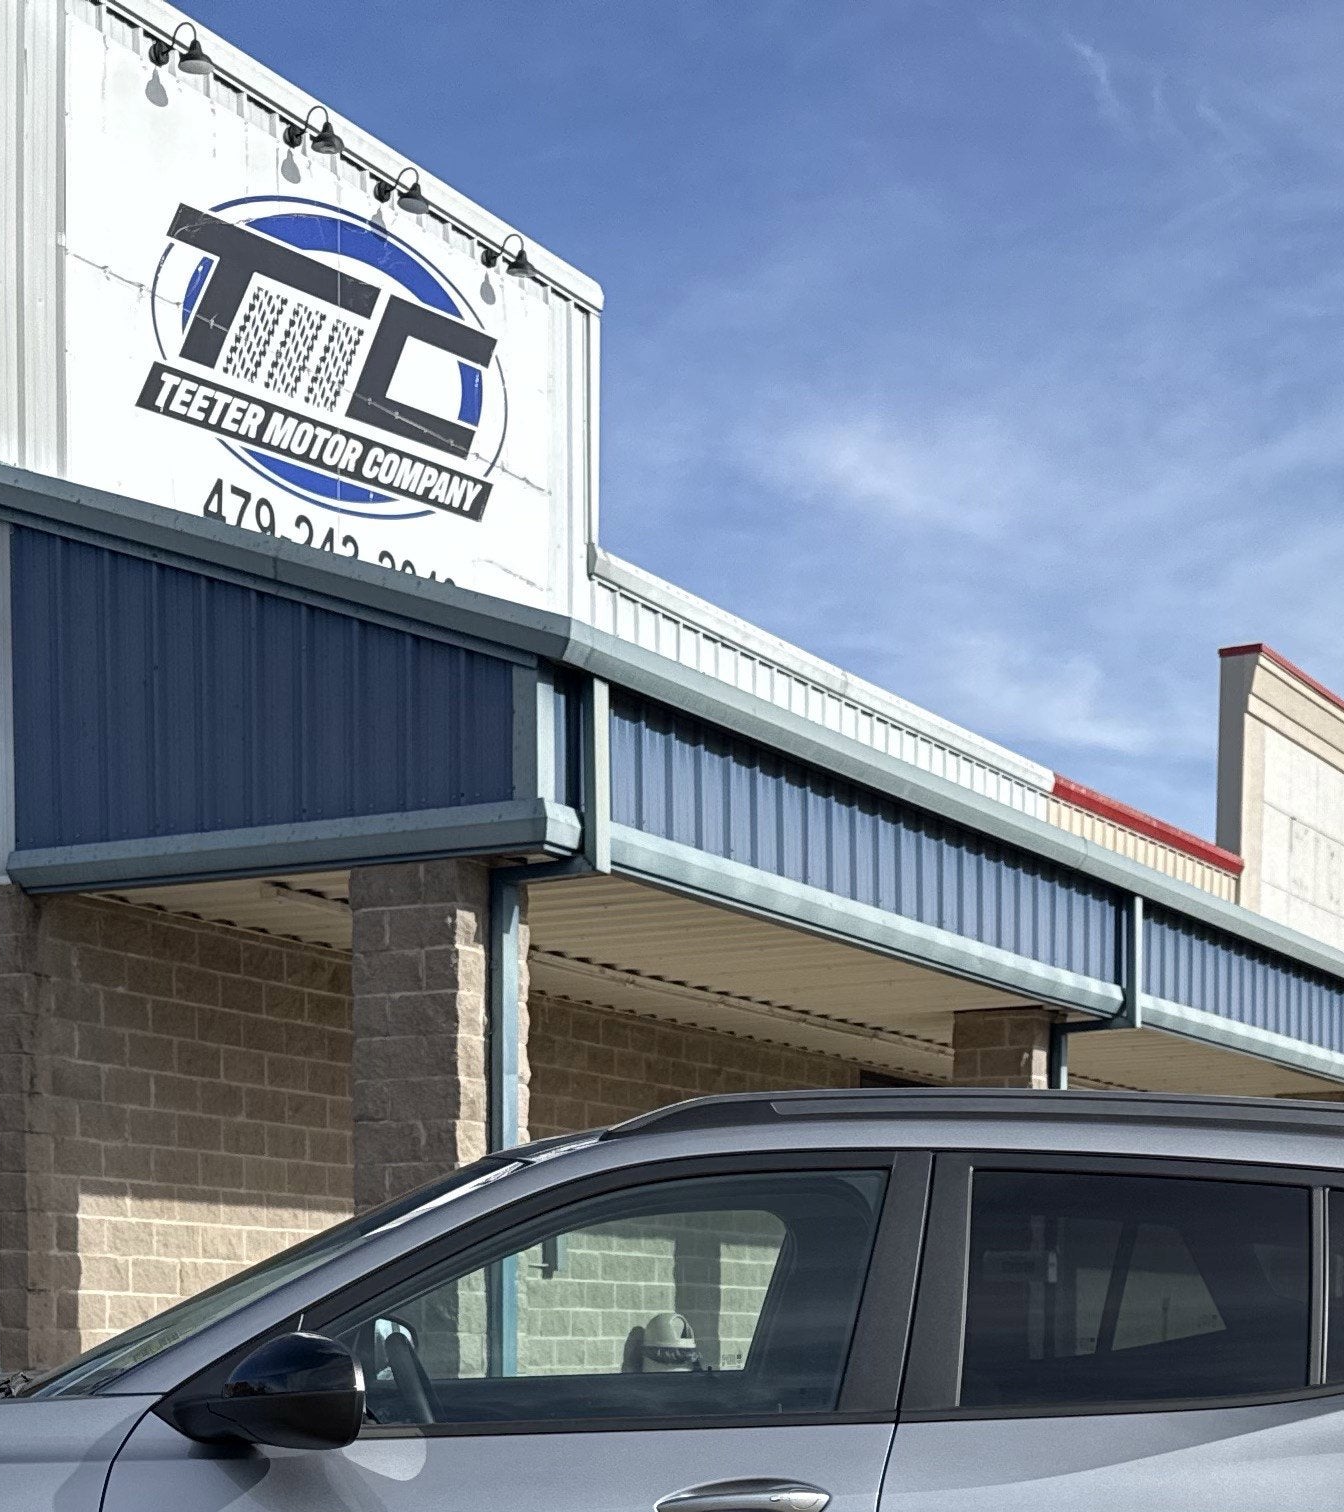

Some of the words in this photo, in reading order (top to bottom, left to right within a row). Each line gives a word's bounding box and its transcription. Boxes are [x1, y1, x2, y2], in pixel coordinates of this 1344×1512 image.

[154, 371, 266, 439] TEETER
[262, 411, 365, 472] MOTOR
[361, 447, 483, 513] COMPANY
